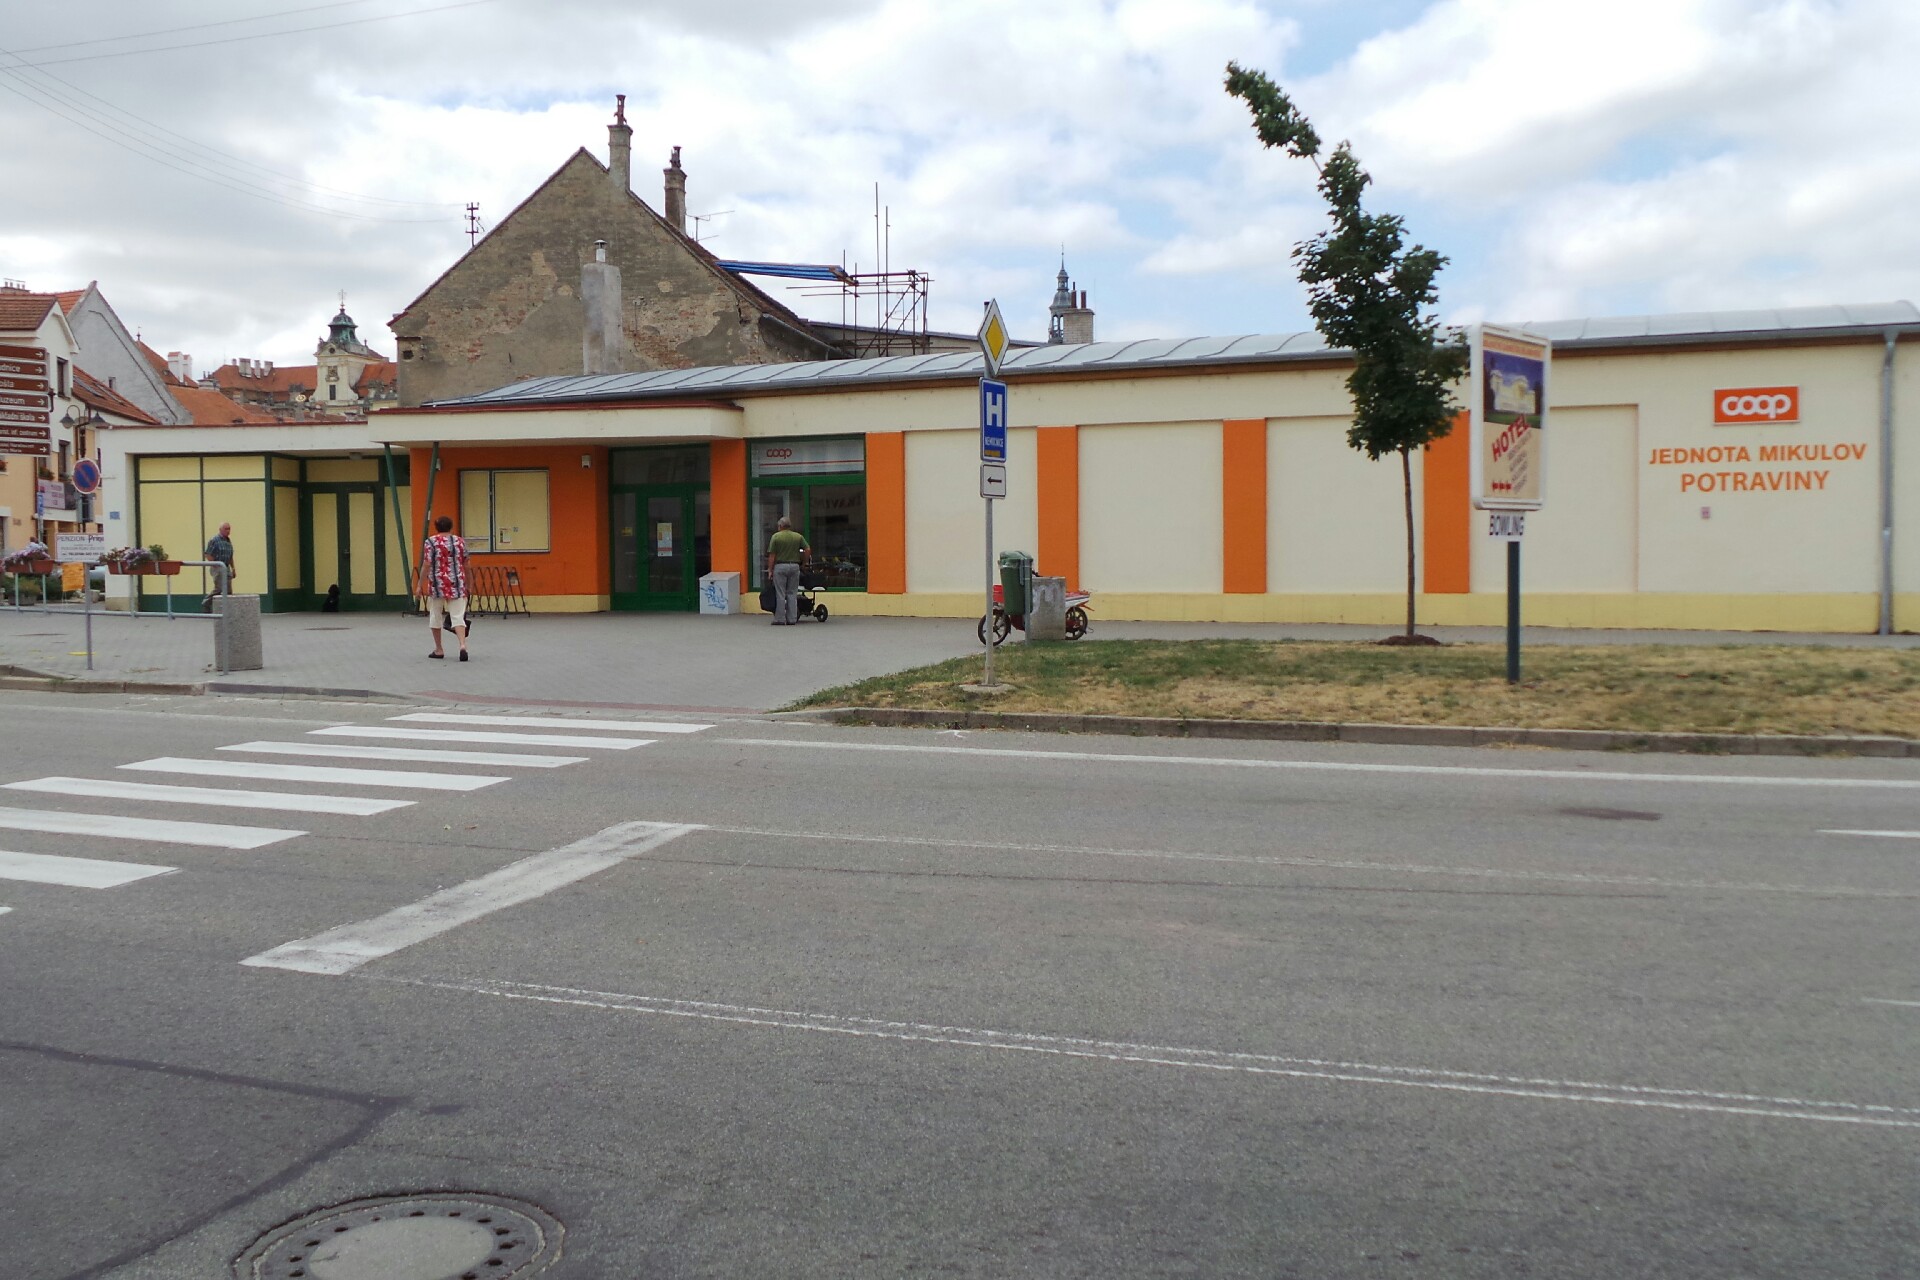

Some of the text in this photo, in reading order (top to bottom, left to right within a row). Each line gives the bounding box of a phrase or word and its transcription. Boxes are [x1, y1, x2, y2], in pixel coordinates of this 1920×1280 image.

[0, 396, 25, 405] uzeum
[986, 391, 1003, 427] H
[1721, 393, 1792, 419] coop
[1491, 413, 1531, 462] HOTEL
[766, 448, 792, 459] coop
[1649, 443, 1868, 464] JEDNOTA MIKULOV
[1680, 470, 1830, 492] POTRAVINY
[1489, 515, 1524, 536] BOWLING
